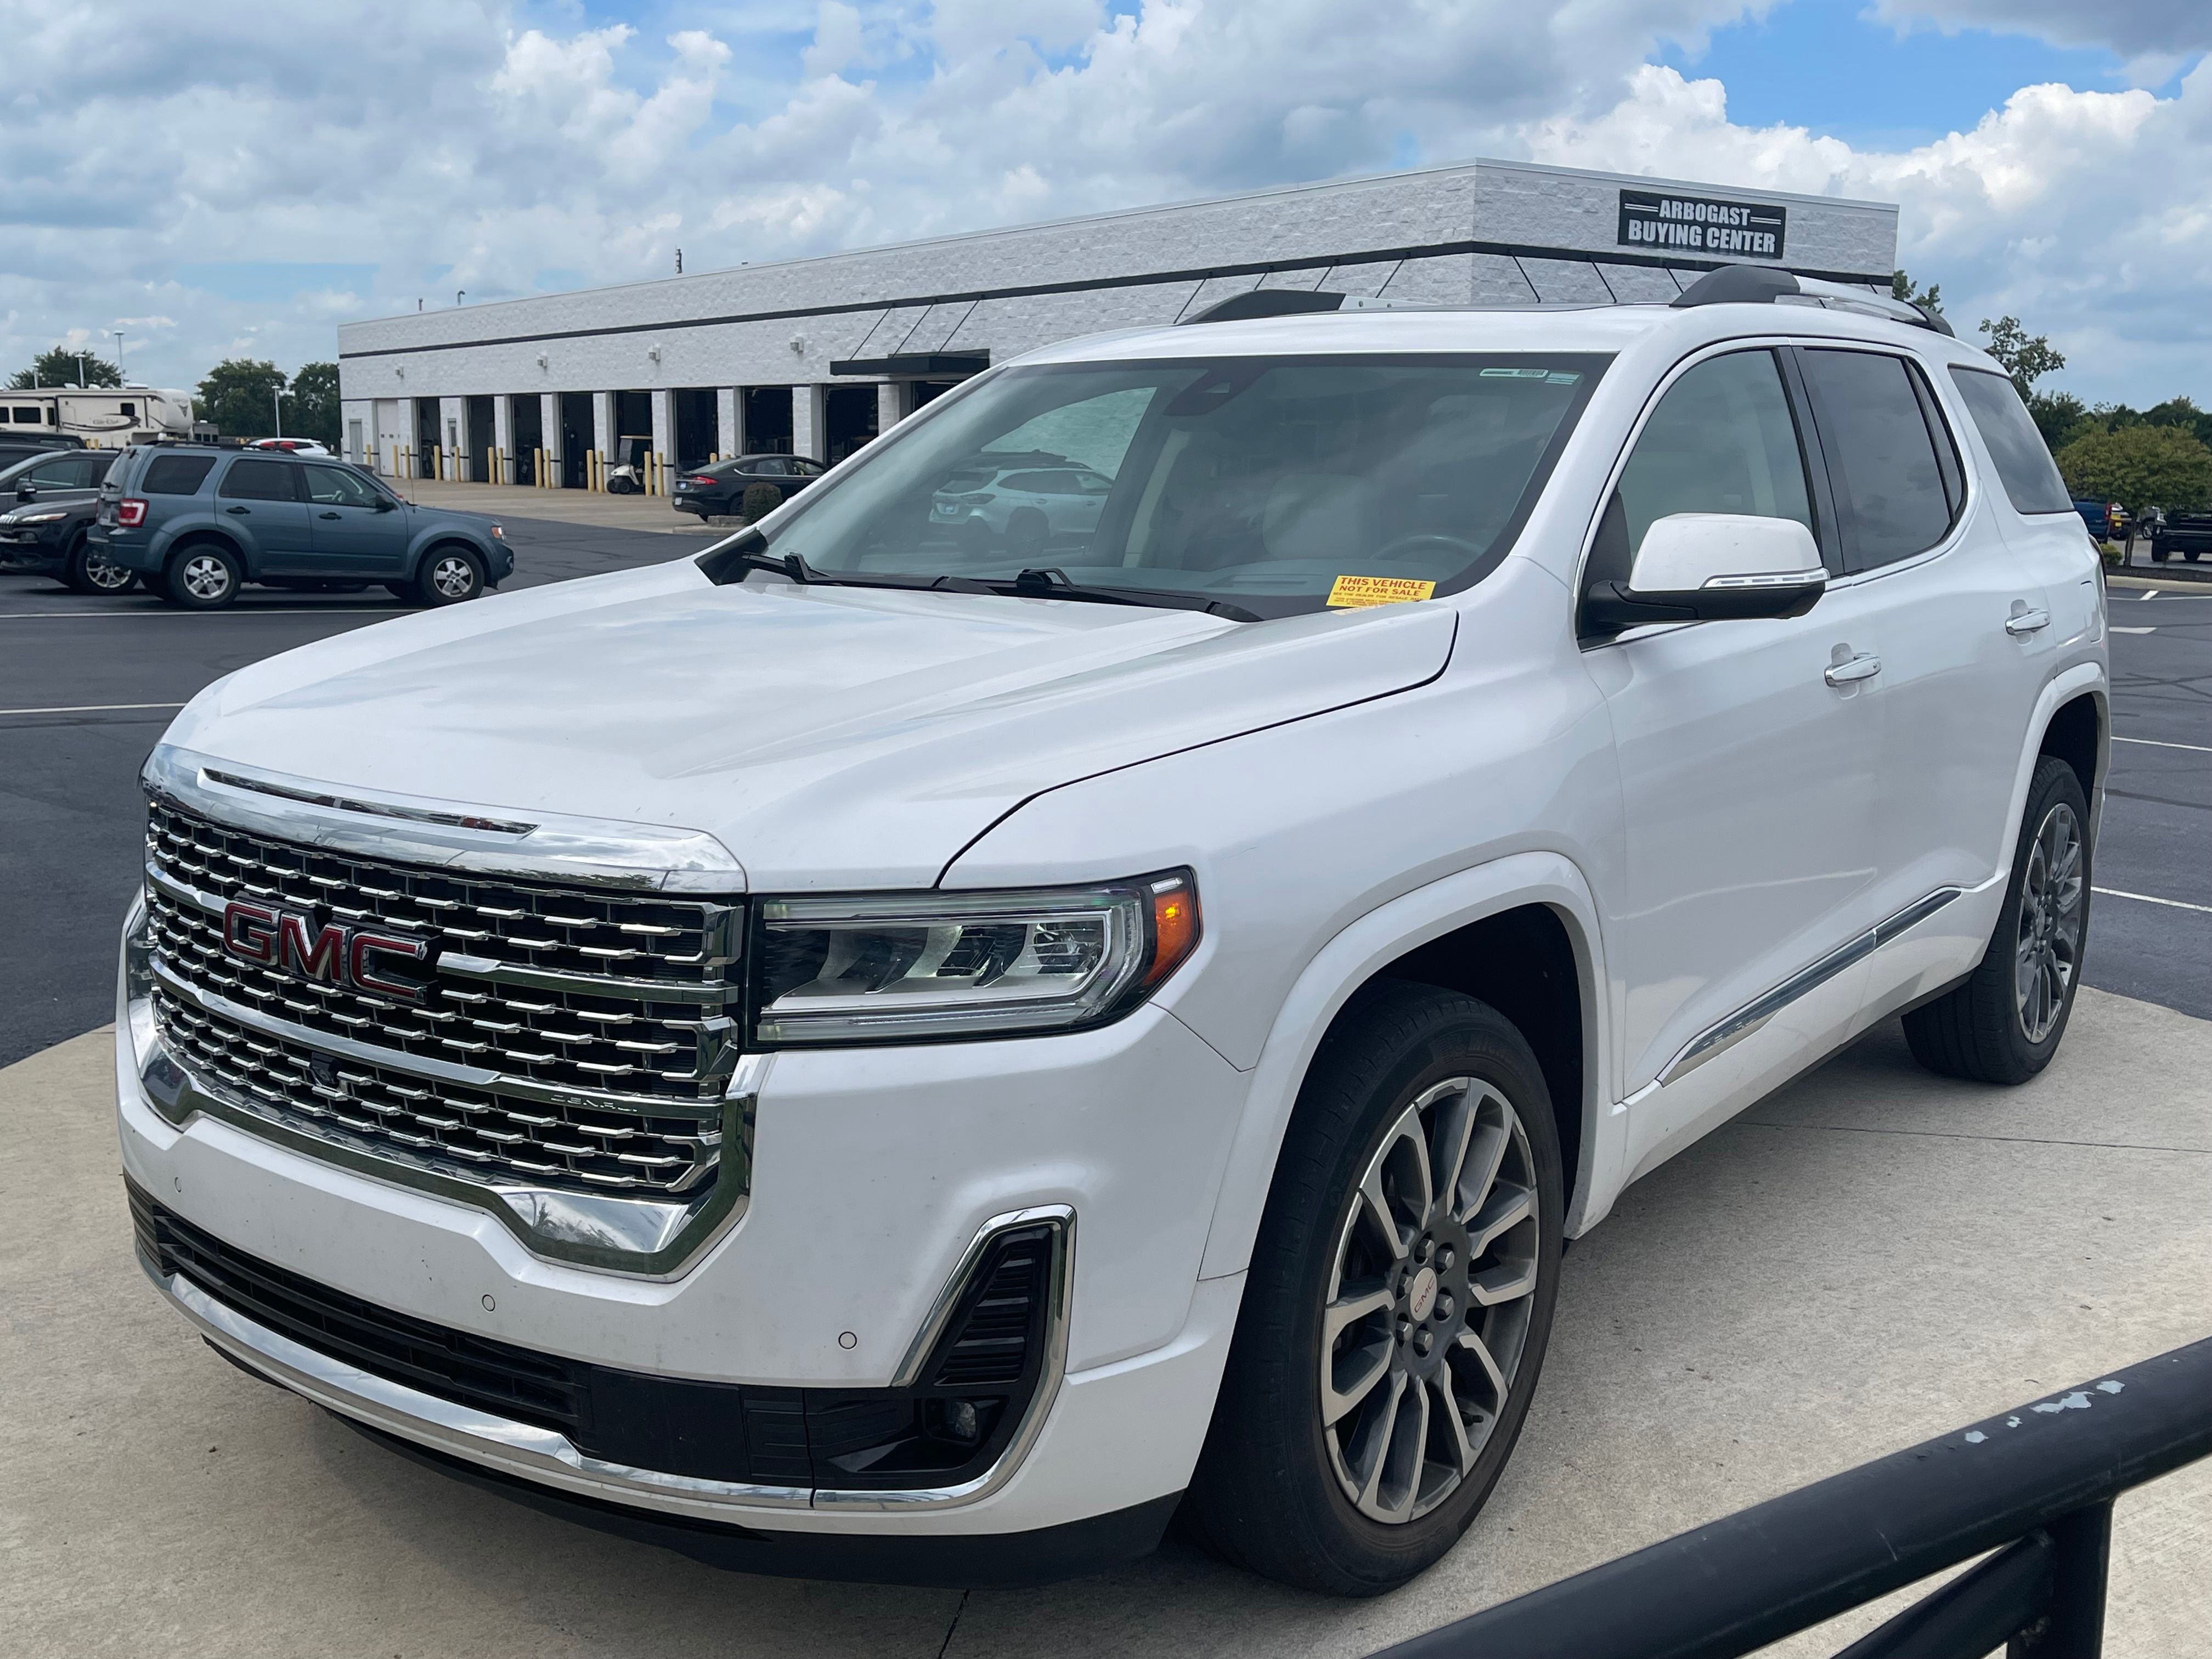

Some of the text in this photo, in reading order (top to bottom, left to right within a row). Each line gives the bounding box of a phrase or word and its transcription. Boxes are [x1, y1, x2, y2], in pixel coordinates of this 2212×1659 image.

[1659, 200, 1751, 226] ARBOGAST
[1628, 219, 1775, 253] BUYING CENTER
[1341, 577, 1426, 590] THIS VEHICLE
[223, 900, 428, 1005] GMC
[1414, 1275, 1435, 1313] GMC
